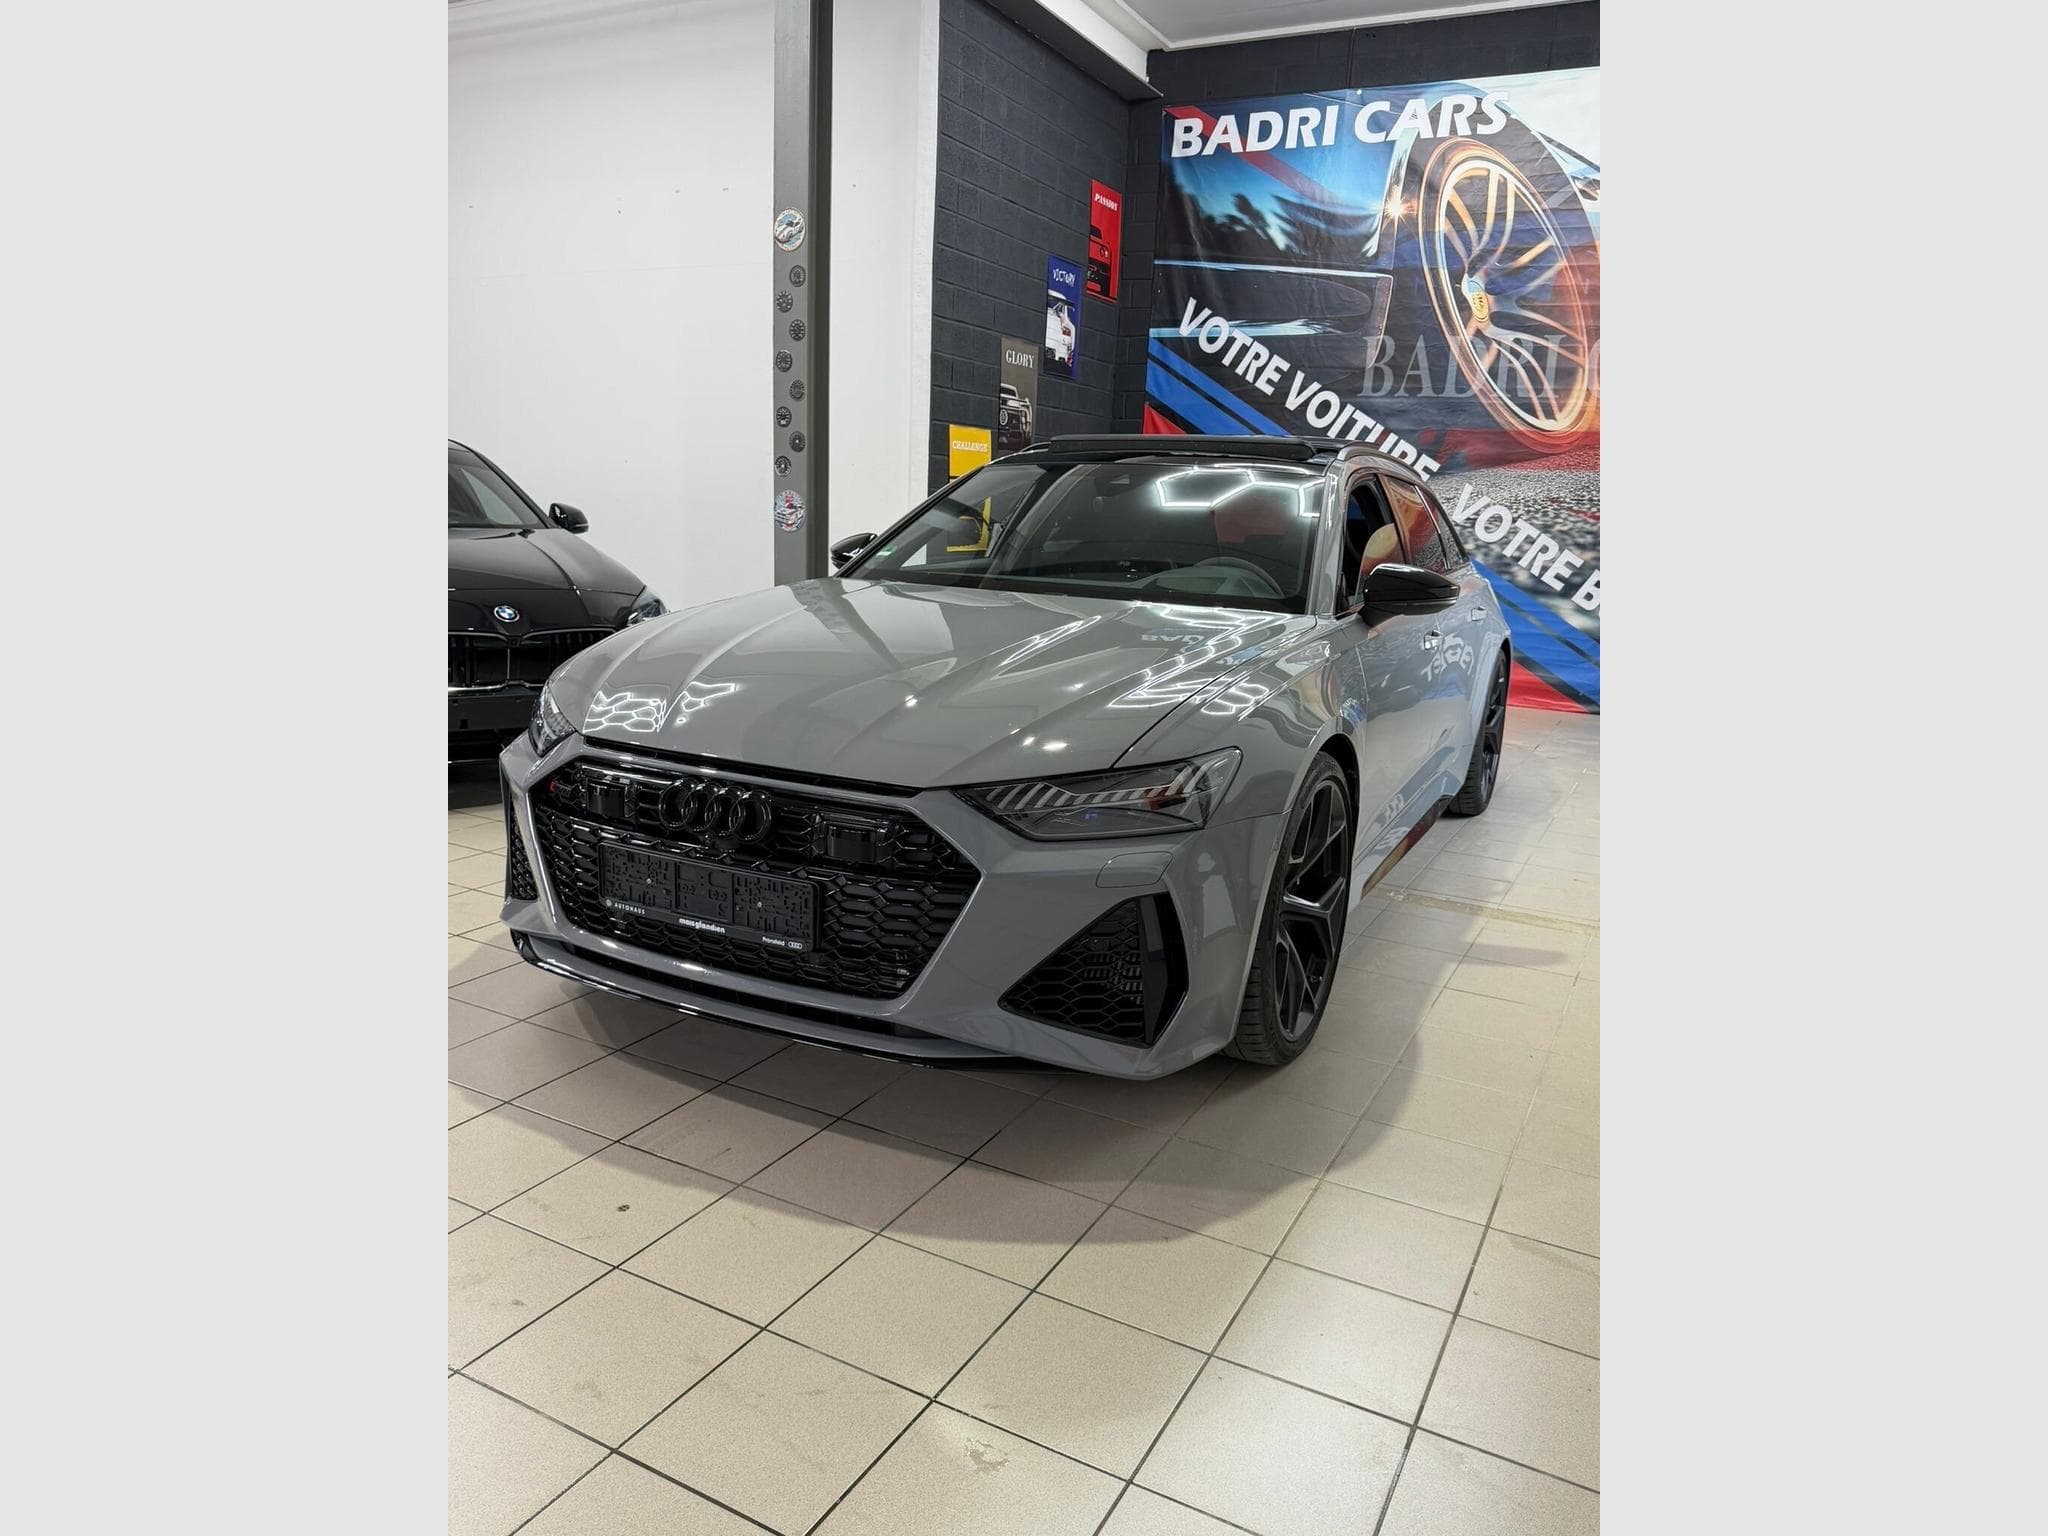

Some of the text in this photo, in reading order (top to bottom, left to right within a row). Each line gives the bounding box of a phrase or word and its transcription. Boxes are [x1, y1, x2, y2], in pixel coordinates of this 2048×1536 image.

[1171, 91, 1510, 158] BADRI CARS
[1053, 269, 1076, 287] VICTORY
[1005, 349, 1035, 368] GLORY
[1357, 334, 1568, 398] BADRI
[1177, 297, 1290, 396] VOTRE
[1452, 483, 1585, 592] VOTRE
[614, 902, 646, 915] AUTOHAUS
